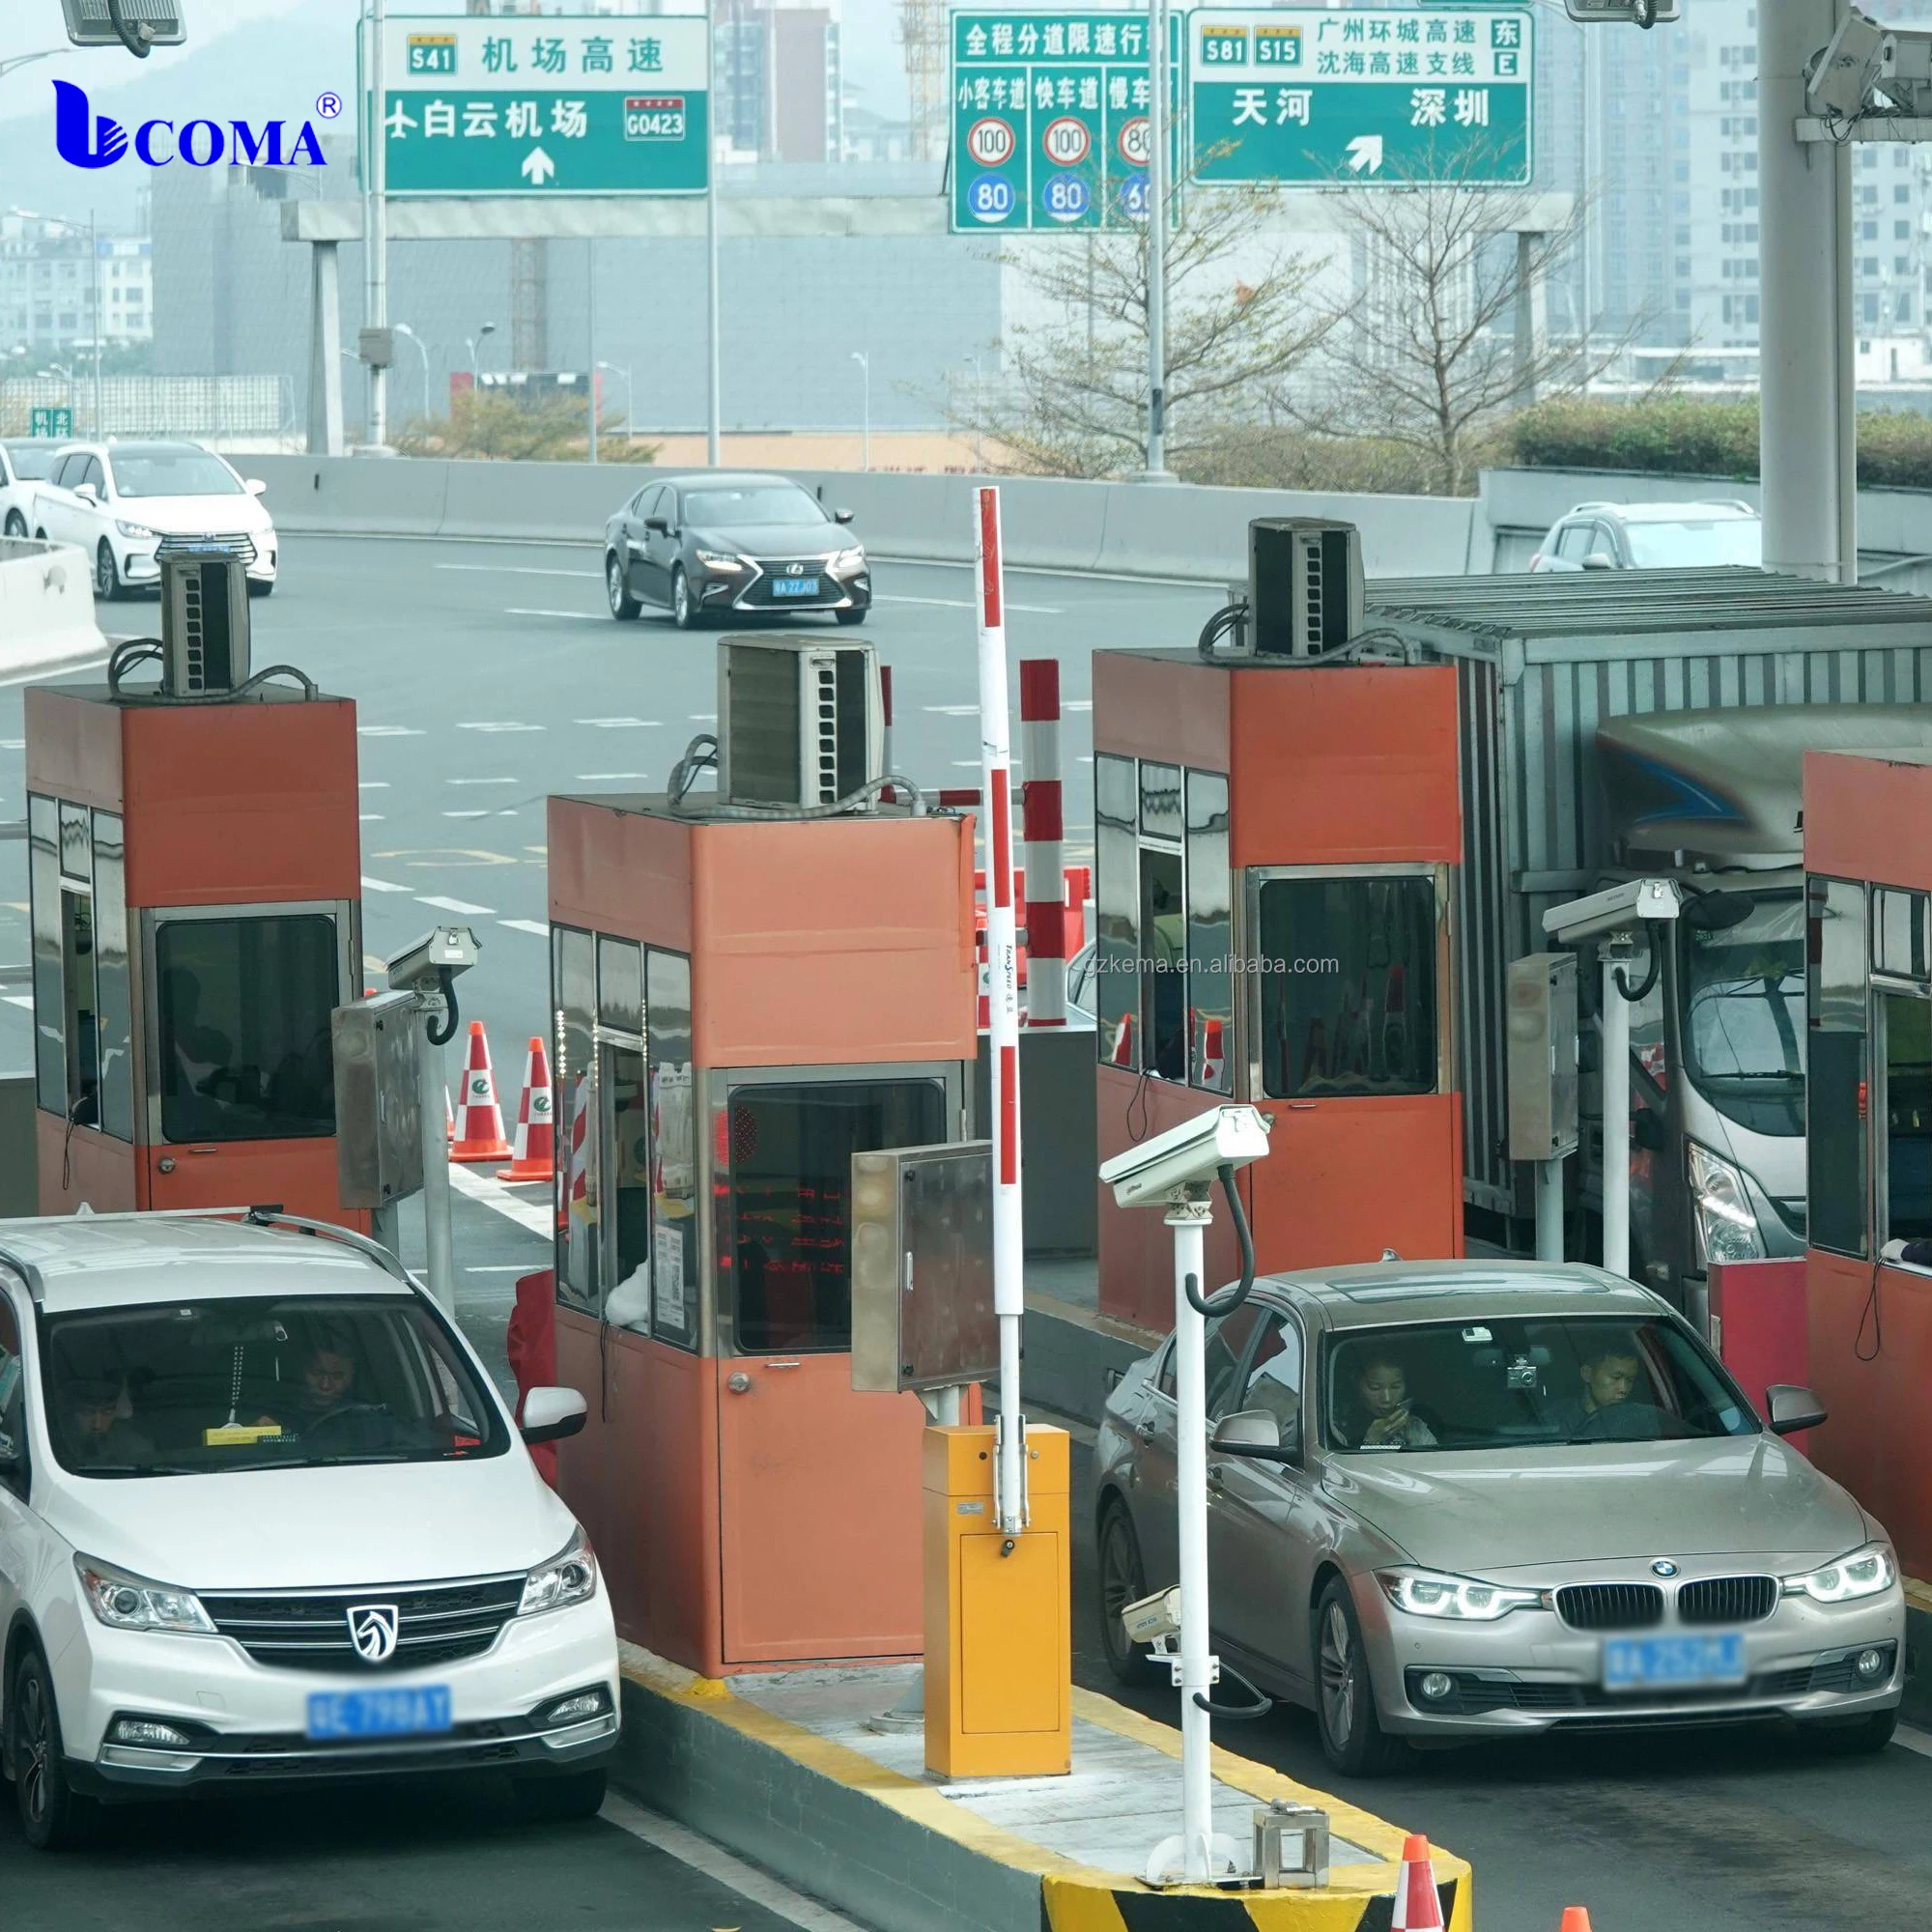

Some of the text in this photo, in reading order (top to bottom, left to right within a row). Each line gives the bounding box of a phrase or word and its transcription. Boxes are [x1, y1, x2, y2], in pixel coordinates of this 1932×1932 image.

[966, 22, 1162, 55] 全程分道限速行
[1317, 18, 1520, 45] 广州环城高速 东
[412, 48, 451, 71] S41
[481, 37, 663, 73] 机场高速
[1207, 40, 1243, 61] S81
[1259, 40, 1296, 61] S15
[1317, 51, 1475, 75] 沈海高速支线
[1499, 54, 1514, 73] E
[958, 76, 1026, 110] 小客车道
[1035, 76, 1098, 110] 快车道
[1109, 76, 1159, 110] 慢车
[424, 99, 587, 138] 白云机场
[1233, 88, 1313, 127] 天河
[1409, 88, 1490, 127] 深圳
[628, 113, 684, 135] G0423
[978, 129, 1007, 154] 100
[1053, 129, 1082, 154] 100
[978, 184, 1008, 211] 80
[1051, 183, 1081, 210] 80
